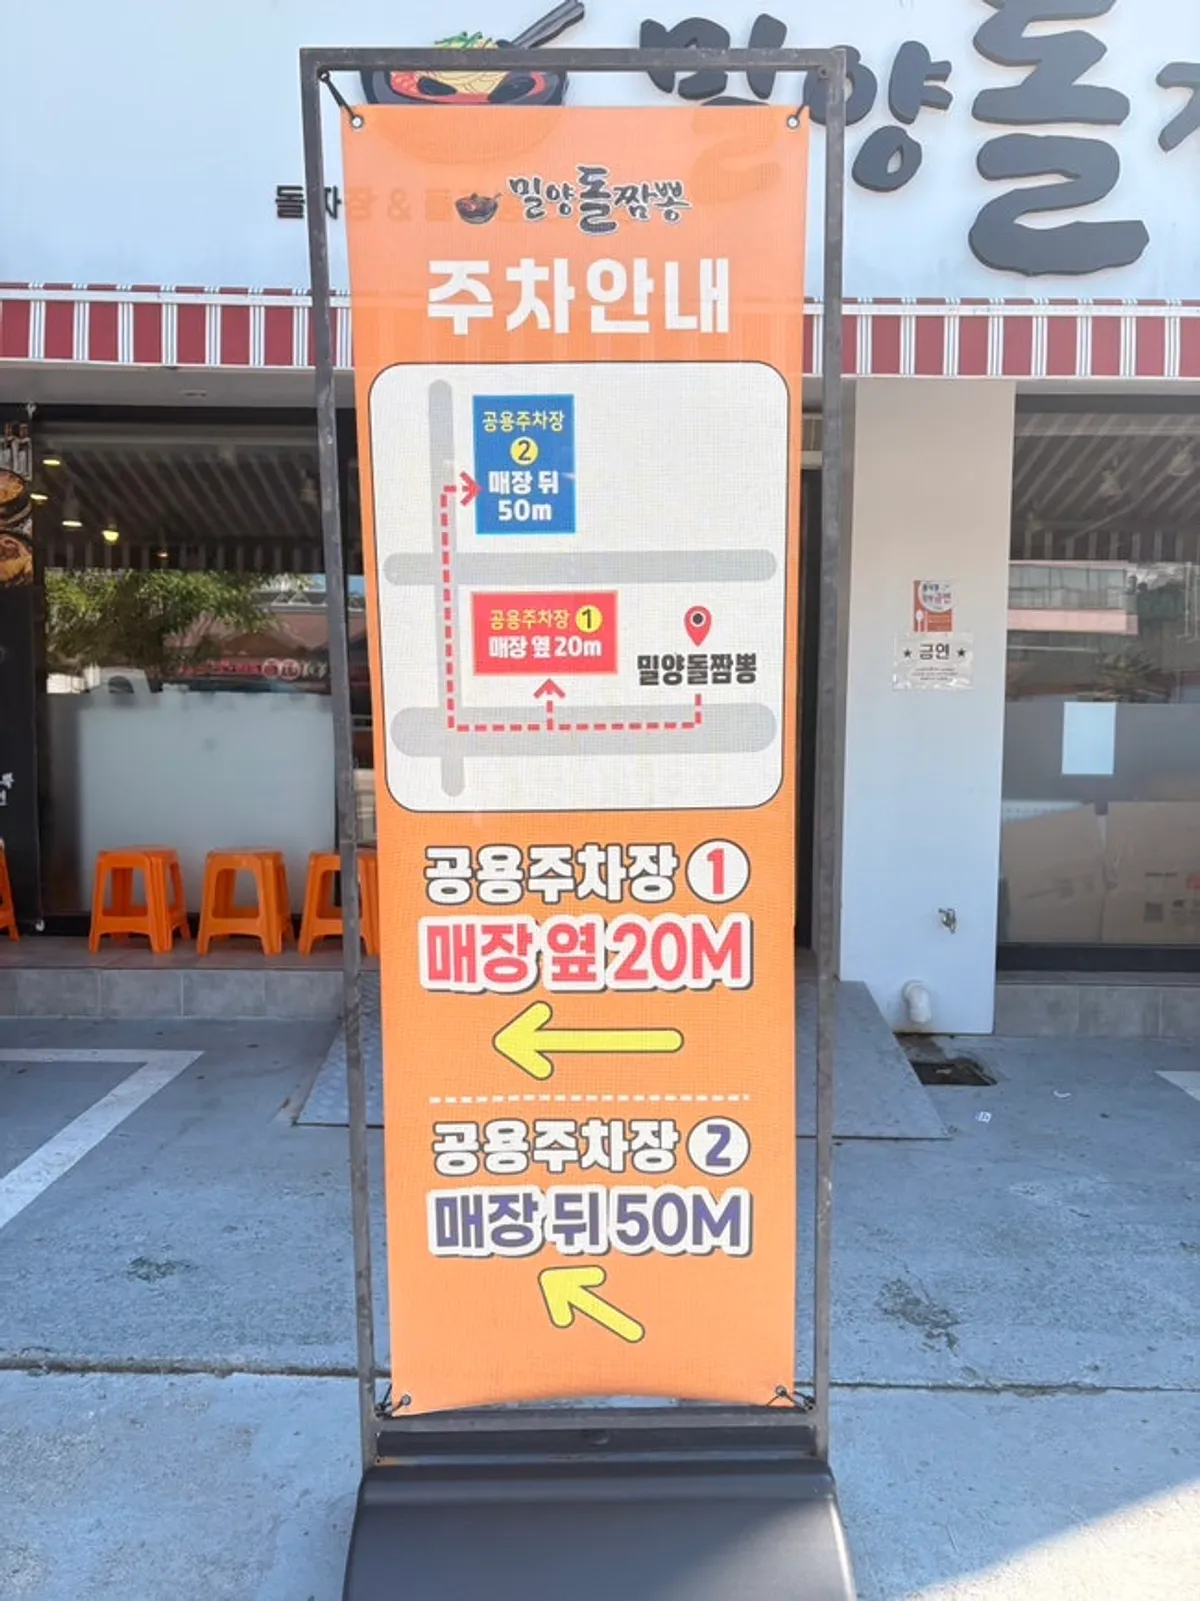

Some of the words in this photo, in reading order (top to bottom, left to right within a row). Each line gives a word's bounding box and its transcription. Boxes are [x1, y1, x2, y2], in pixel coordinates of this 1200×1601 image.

[509, 165, 692, 234] 밀양돌짬뽕
[428, 257, 730, 336] 주차안내
[482, 410, 565, 432] 공용주차장
[516, 438, 534, 463] 2
[488, 471, 533, 495] 매장
[538, 471, 559, 494] 뒤
[498, 499, 552, 521] 50m
[489, 609, 570, 630] 공용주차장
[488, 636, 528, 659] 매장
[531, 635, 551, 659] 옆
[554, 637, 602, 657] 20m
[919, 642, 951, 661] 금연
[637, 653, 757, 686] 밀양돌짬뽕
[424, 842, 680, 905] 공용주차장
[425, 921, 534, 985] 매장
[545, 921, 598, 981] 옆
[612, 920, 743, 983] 20M
[431, 1117, 680, 1176] 공용주차장
[434, 1192, 539, 1250] 매장
[550, 1192, 597, 1248] 뒤
[615, 1191, 742, 1249] 50M
